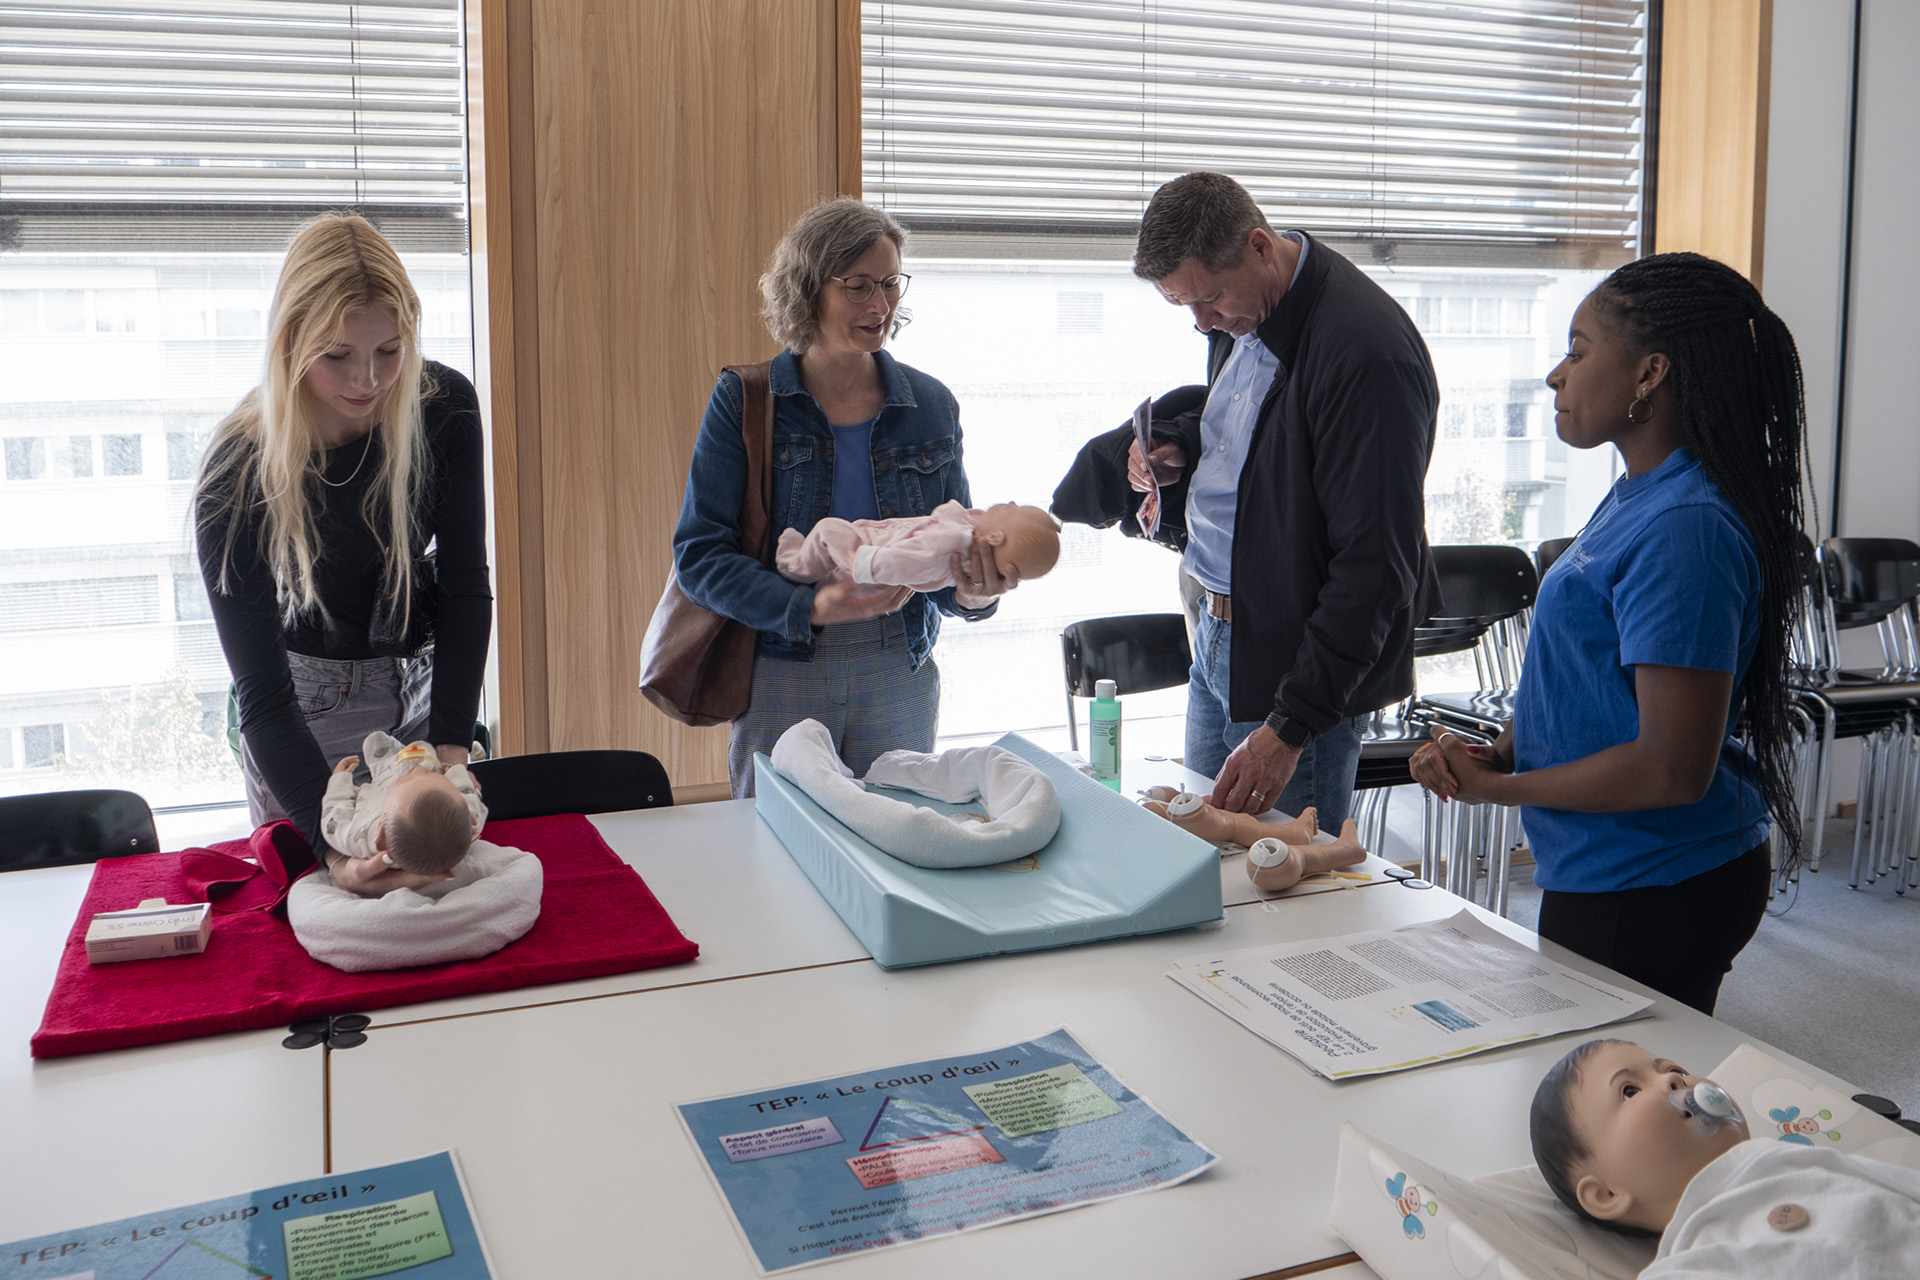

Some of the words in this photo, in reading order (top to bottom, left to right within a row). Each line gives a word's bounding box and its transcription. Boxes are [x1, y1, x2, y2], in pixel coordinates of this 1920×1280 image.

[107, 923, 124, 931] 5%
[167, 916, 195, 926] Emla
[1270, 1001, 1291, 1016] triage
[1295, 1008, 1308, 1016] de
[1300, 1002, 1313, 1010] ou
[1289, 1014, 1302, 1022] de
[1298, 1021, 1317, 1032] outil
[1310, 1008, 1339, 1027] malade
[1294, 1028, 1342, 1058] Pédiatrie
[1332, 1043, 1345, 1051] Le
[1335, 1025, 1378, 1052] gravement
[1344, 1041, 1367, 1054] pour
[749, 1095, 808, 1113] TEP:
[836, 1086, 867, 1098] Le
[874, 1071, 935, 1090] coup
[942, 1060, 1001, 1079] d'œil
[976, 1086, 1014, 1098] Position
[1015, 1076, 1061, 1092] spontanée
[994, 1072, 1049, 1089] Respiration
[981, 1089, 1035, 1104] Mouvement
[1035, 1085, 1053, 1094] des
[983, 1095, 1036, 1111] thoraciques
[989, 1100, 1048, 1116] abdominales
[996, 1109, 1030, 1121] Travail
[1000, 1117, 1031, 1129] signes
[725, 1133, 763, 1143] Aspect
[765, 1124, 805, 1137] général
[771, 1127, 826, 1142] conscience
[736, 1146, 767, 1155] Tonus
[769, 1135, 823, 1149] musculaire
[852, 1145, 942, 1166] Hémodynamique
[830, 1203, 870, 1216] Permet
[993, 1169, 1029, 1183] patient
[295, 1222, 343, 1236] Position
[346, 1208, 408, 1227] spontanée
[324, 1203, 397, 1222] Respiration
[798, 1221, 826, 1233] C'est
[828, 1217, 850, 1227] une
[851, 1205, 909, 1223] évaluation
[13, 1242, 87, 1265] TEP:
[131, 1226, 167, 1243] Le
[180, 1205, 260, 1231] coup
[272, 1185, 349, 1211] d'œil
[295, 1225, 366, 1243] Mouvement
[369, 1218, 391, 1230] des
[393, 1210, 430, 1225] parois
[292, 1234, 362, 1252] thoraciques
[365, 1230, 377, 1238] et
[293, 1240, 371, 1260] abdominales
[788, 1246, 799, 1255] Si
[802, 1237, 837, 1252] risque
[838, 1231, 863, 1243] vital
[299, 1252, 340, 1267] Travail
[343, 1239, 412, 1259] respiratoire
[295, 1263, 337, 1277] signes
[339, 1259, 355, 1268] de
[341, 1254, 417, 1276] respiratoires
